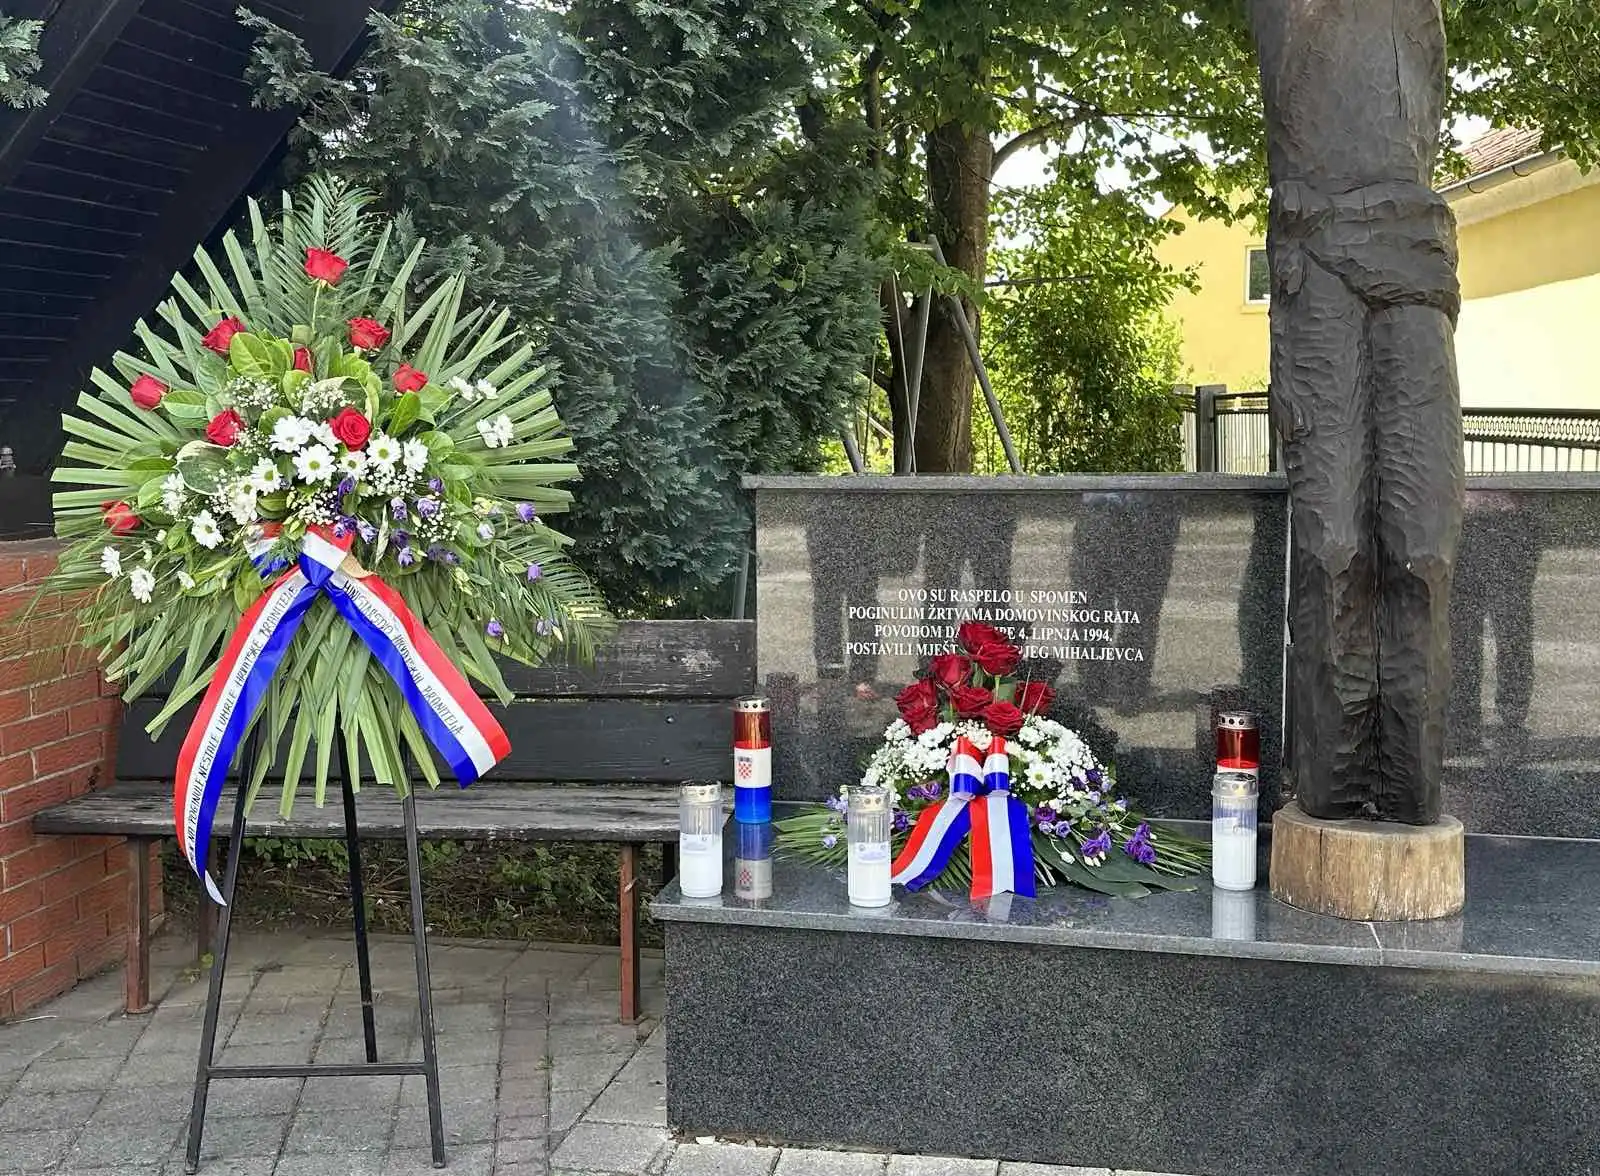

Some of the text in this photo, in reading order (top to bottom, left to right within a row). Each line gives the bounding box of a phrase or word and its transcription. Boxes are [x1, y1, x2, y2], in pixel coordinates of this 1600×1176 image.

[898, 588, 1088, 604] OVO SU RASPELO U SPOMEN
[849, 603, 1140, 624] POGINULIM ŽRTVAMA DOMOVINSKOG RATA
[874, 624, 942, 638] POVODOM
[1018, 628, 1029, 640] 4.
[1032, 627, 1080, 641] LIPNJA
[1083, 628, 1113, 642] 1994.
[846, 642, 913, 655] POSTAVILI
[916, 640, 959, 656] MJEŠT
[1053, 646, 1144, 661] MIHALJEVCA
